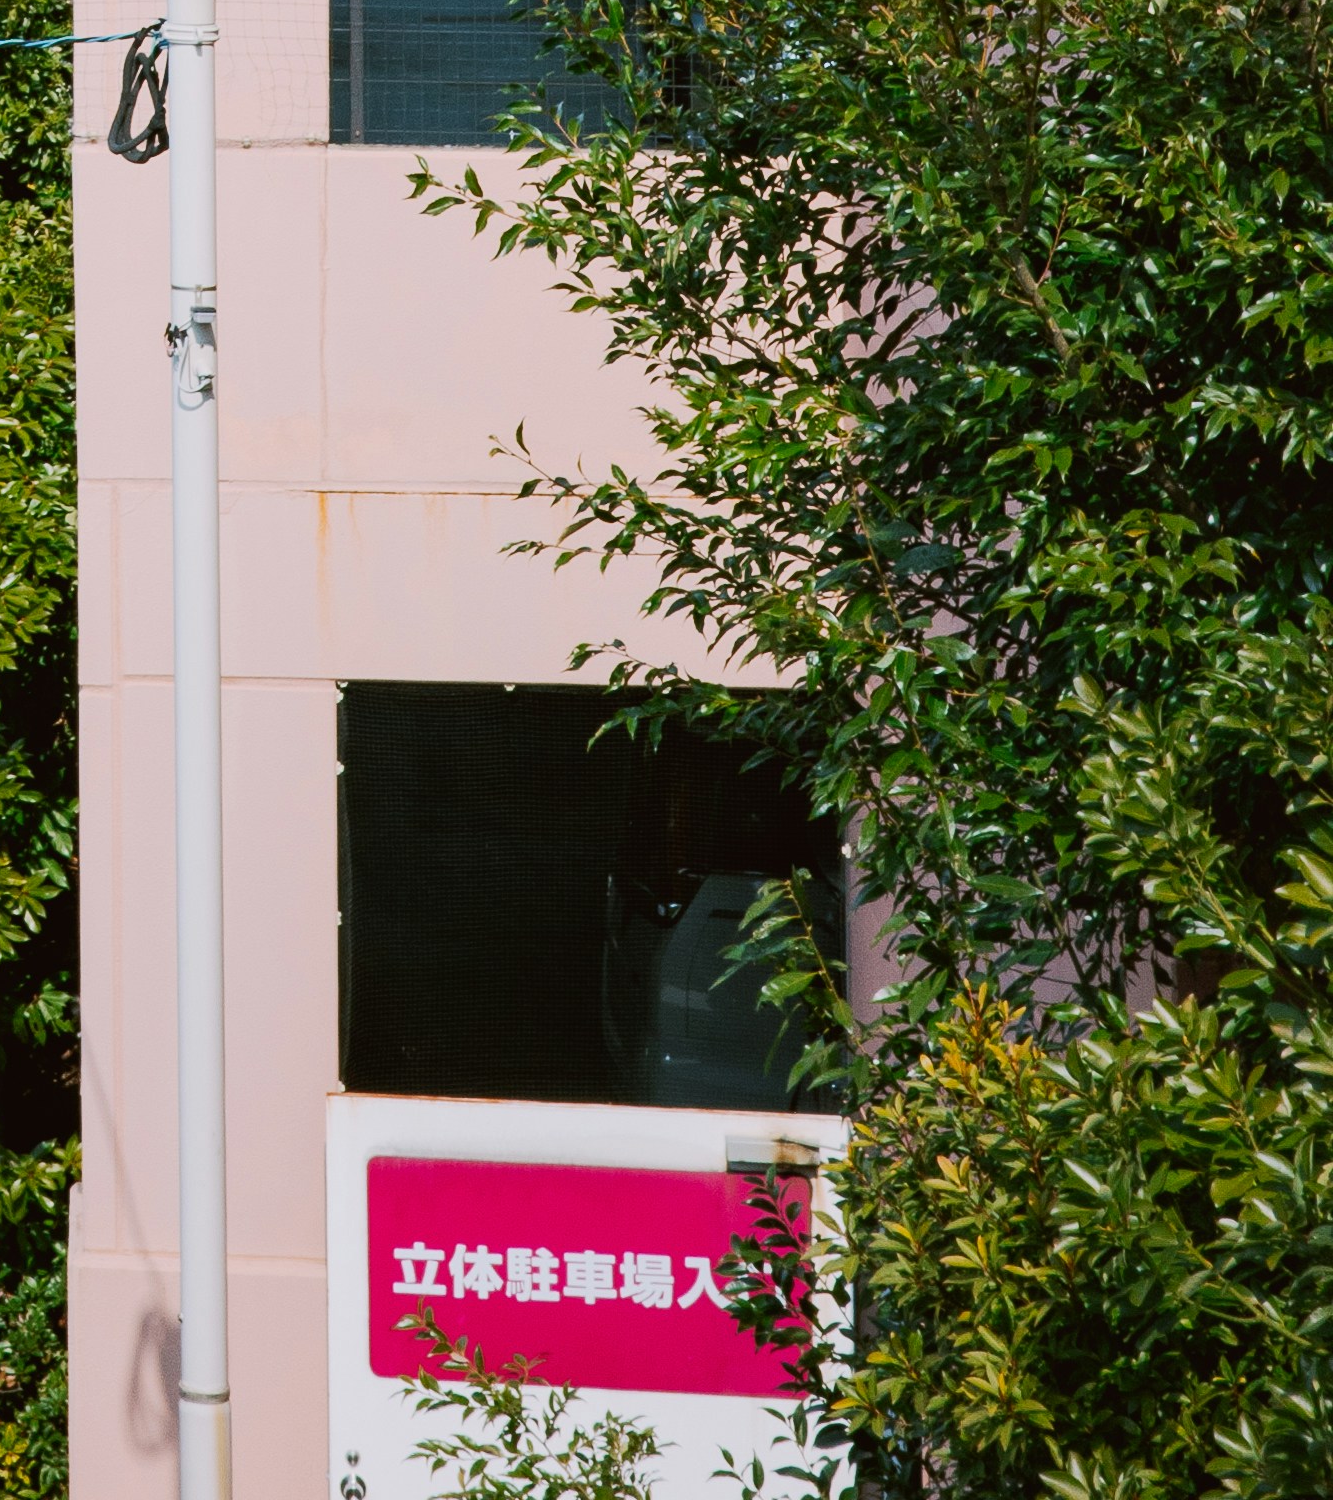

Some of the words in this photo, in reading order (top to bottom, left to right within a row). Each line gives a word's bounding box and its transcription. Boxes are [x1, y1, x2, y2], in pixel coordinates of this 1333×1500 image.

[392, 1241, 787, 1311] 立体駐車場入
